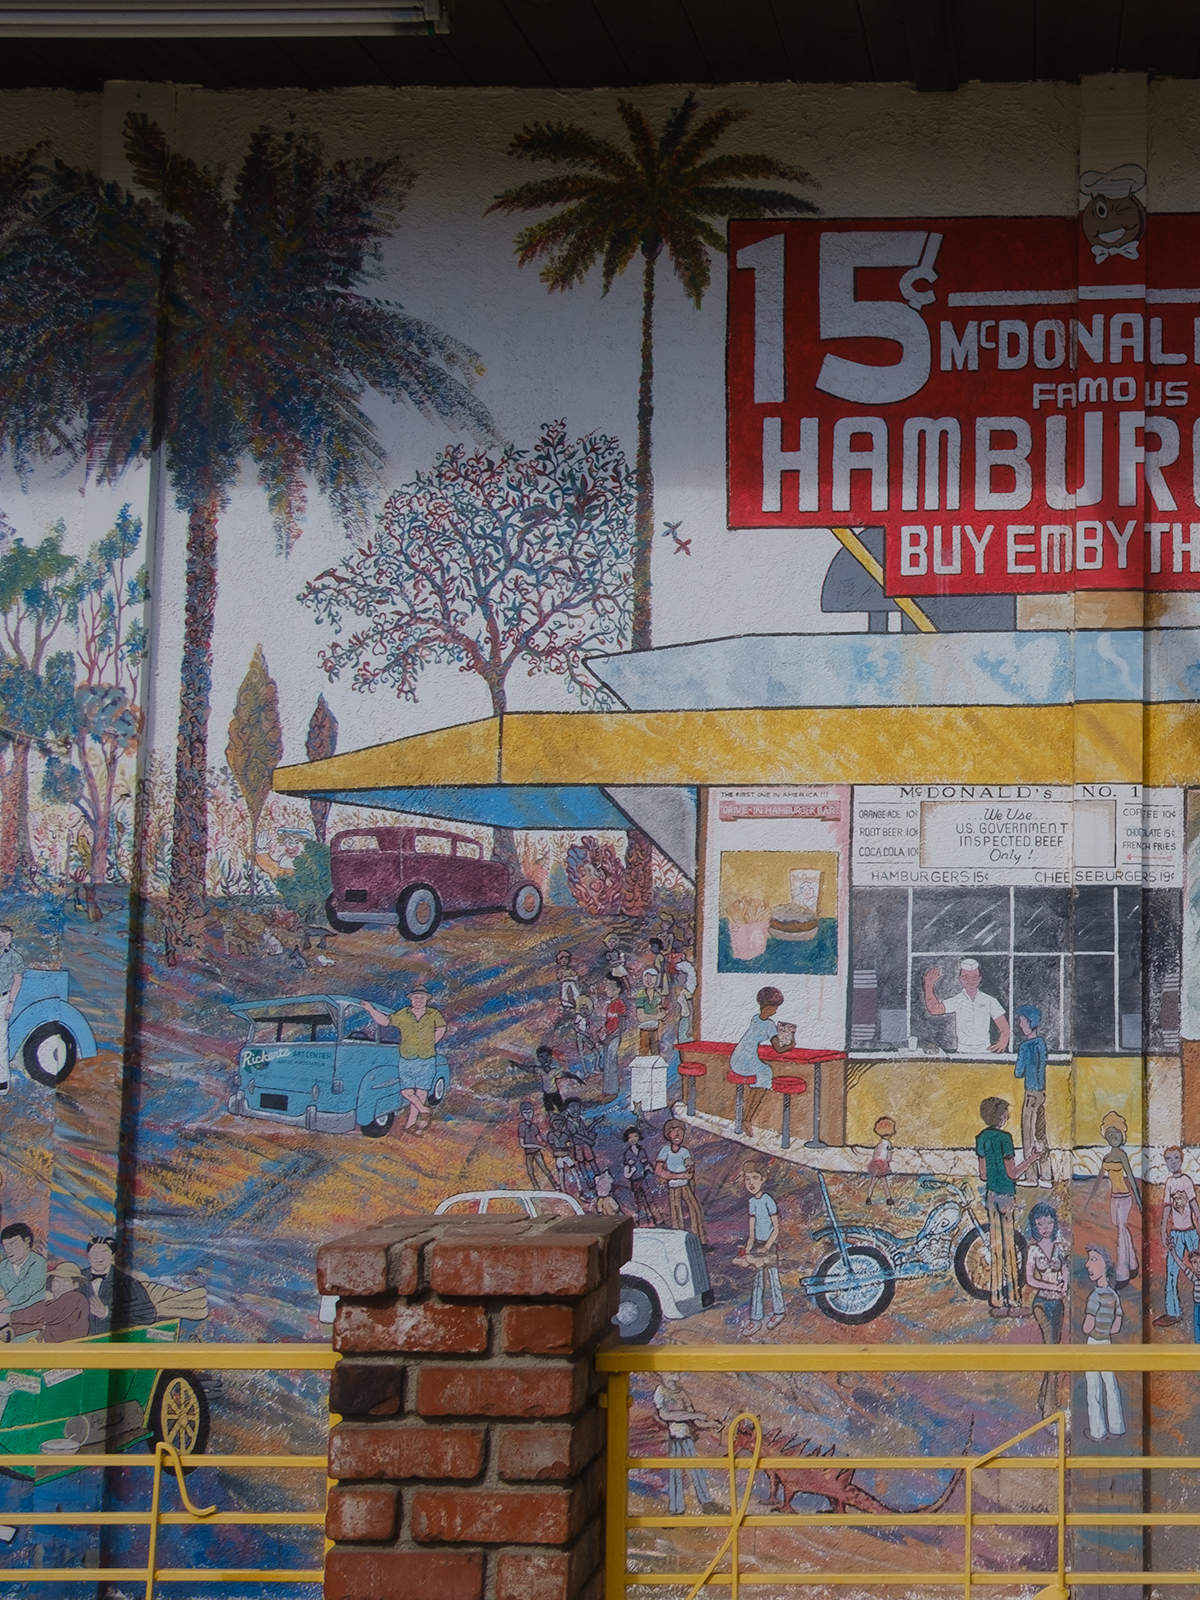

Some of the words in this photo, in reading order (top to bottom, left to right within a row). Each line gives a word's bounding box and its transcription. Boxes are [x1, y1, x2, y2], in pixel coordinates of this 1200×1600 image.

[1033, 376, 1189, 410] FAMOUS
[901, 523, 994, 577] BUY
[1075, 519, 1138, 572] BY
[1081, 785, 1117, 798] NO.
[1130, 785, 1140, 798] 1
[764, 806, 817, 816] HAMBURGER
[817, 806, 837, 816] BAR
[858, 809, 886, 819] ORANGE
[1122, 808, 1159, 821] COFFEE
[1162, 810, 1177, 819] 10¢
[859, 828, 881, 838] ROOT
[882, 828, 903, 838] BEER
[955, 823, 975, 834] U.S.
[978, 822, 1069, 834] GOVERNMENT
[1126, 828, 1162, 838] CHOCOLATE
[959, 835, 1031, 847] INSPECTED
[1034, 836, 1064, 847] BEEF
[1122, 842, 1151, 851] FRENCH
[1153, 842, 1177, 851] FRIES
[989, 849, 1022, 865] Only
[871, 871, 970, 883] HAMBURGERS
[973, 871, 989, 883] 15¢
[1034, 871, 1157, 883] CHEESEBURGERS
[1159, 871, 1175, 883] 19¢
[292, 1050, 306, 1059] ART
[306, 1050, 332, 1060] CENTER
